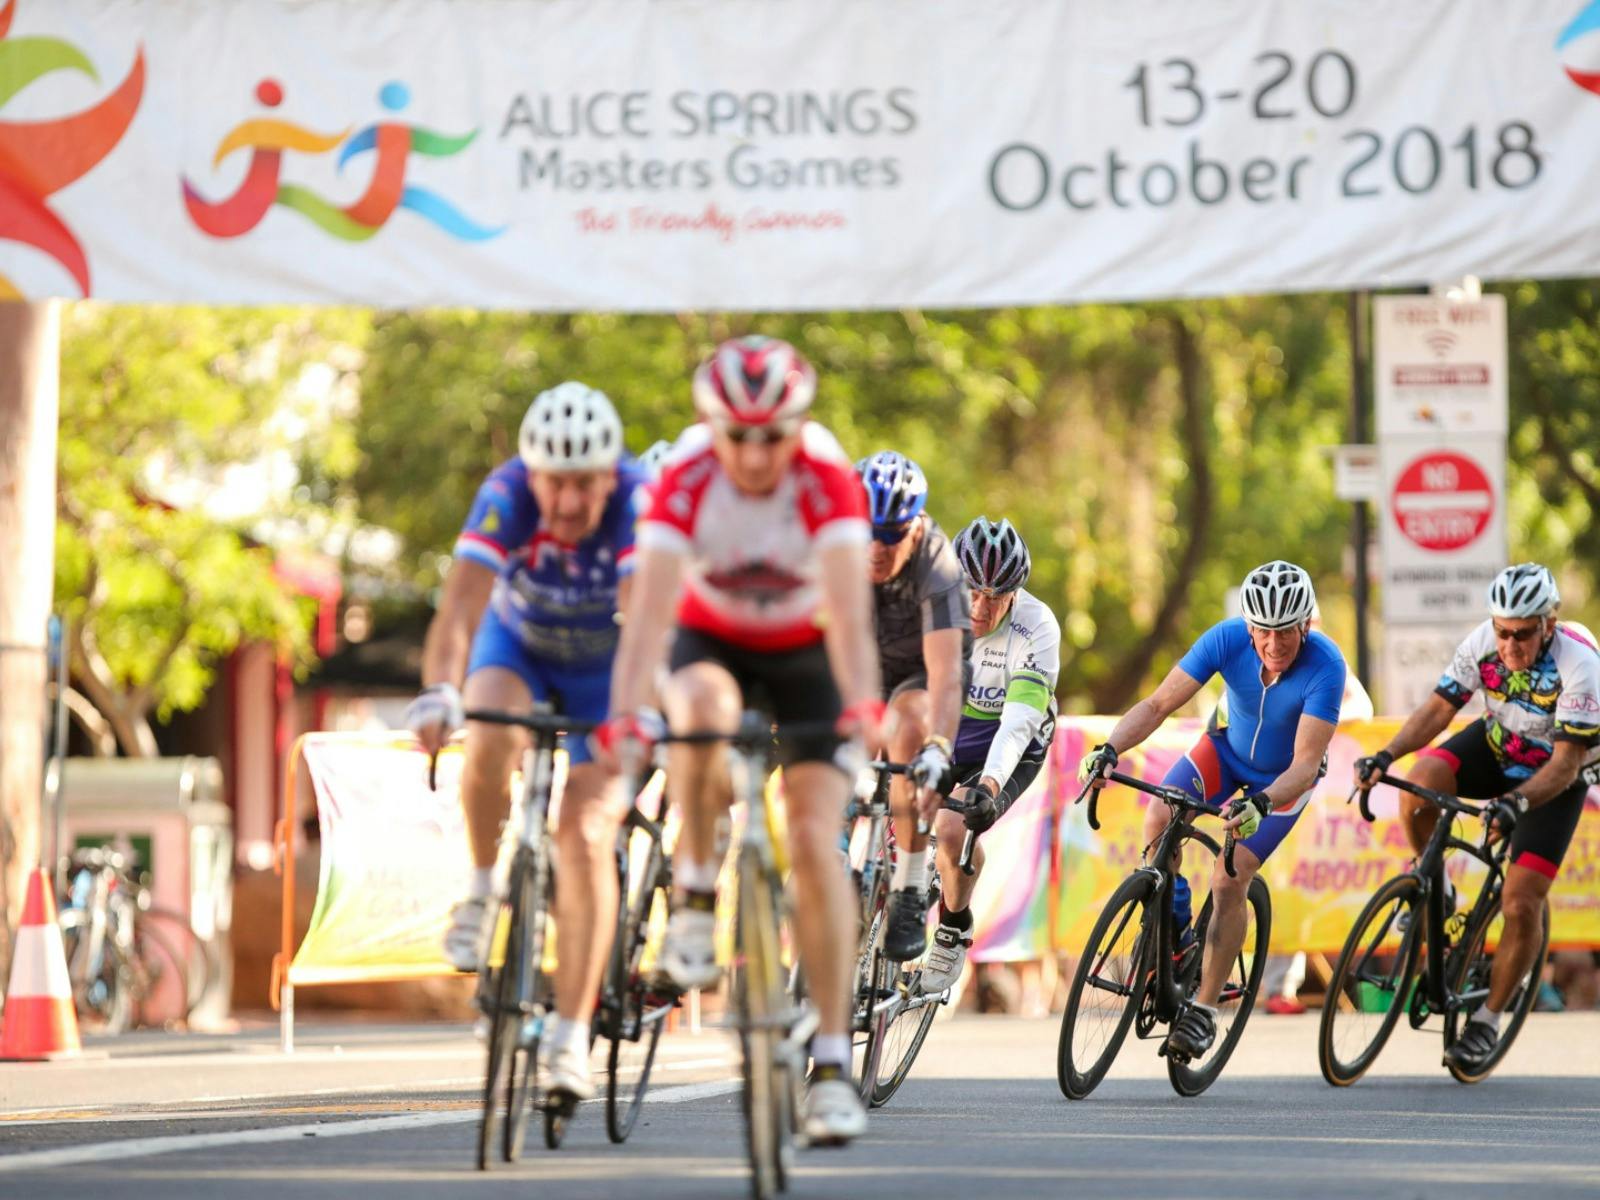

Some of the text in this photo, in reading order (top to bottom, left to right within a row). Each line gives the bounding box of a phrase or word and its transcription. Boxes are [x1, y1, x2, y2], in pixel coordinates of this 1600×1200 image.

[1125, 50, 1357, 127] 13-20
[500, 86, 919, 139] ALICE SPRINGS
[518, 143, 901, 191] Masters Games
[987, 120, 1544, 212] October 2018
[1420, 460, 1460, 491] NO
[1404, 511, 1478, 541] ENTRY
[1314, 815, 1373, 849] IT'S
[1290, 857, 1389, 892] ABOUT
